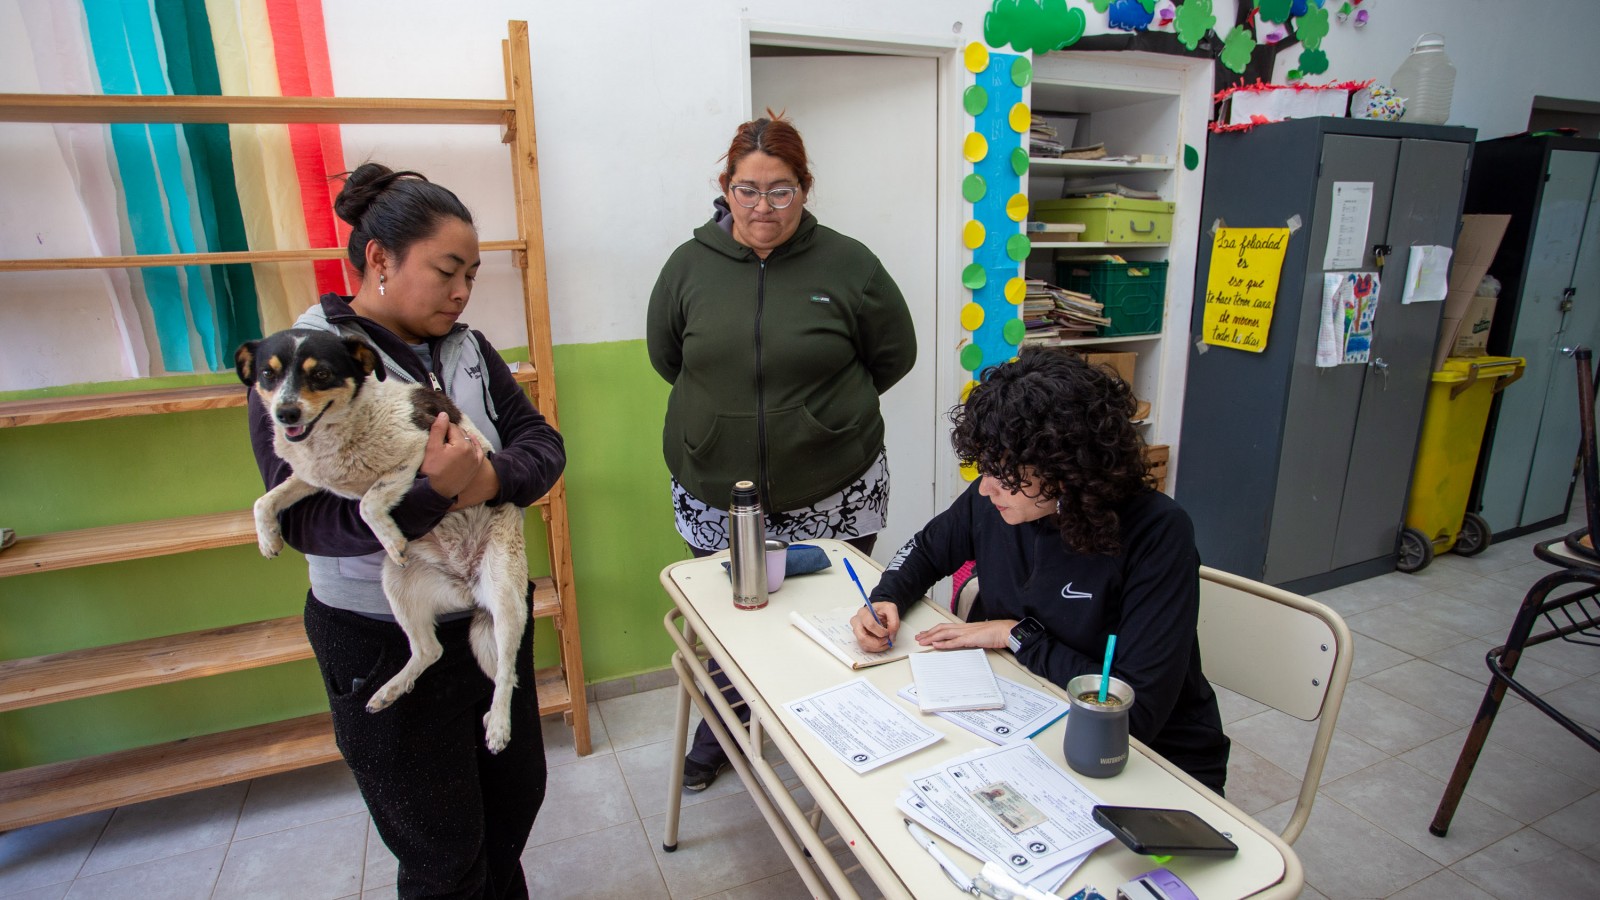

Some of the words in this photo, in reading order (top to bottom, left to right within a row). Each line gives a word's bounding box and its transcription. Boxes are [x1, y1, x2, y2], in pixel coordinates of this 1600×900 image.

[1217, 230, 1236, 249] La
[1237, 258, 1248, 269] es
[1228, 276, 1242, 287] eso
[1246, 279, 1265, 294] que
[1206, 290, 1215, 304] te
[1215, 291, 1232, 304] hace
[1253, 298, 1272, 309] cara
[1219, 309, 1230, 323] de
[1212, 325, 1230, 342] todos
